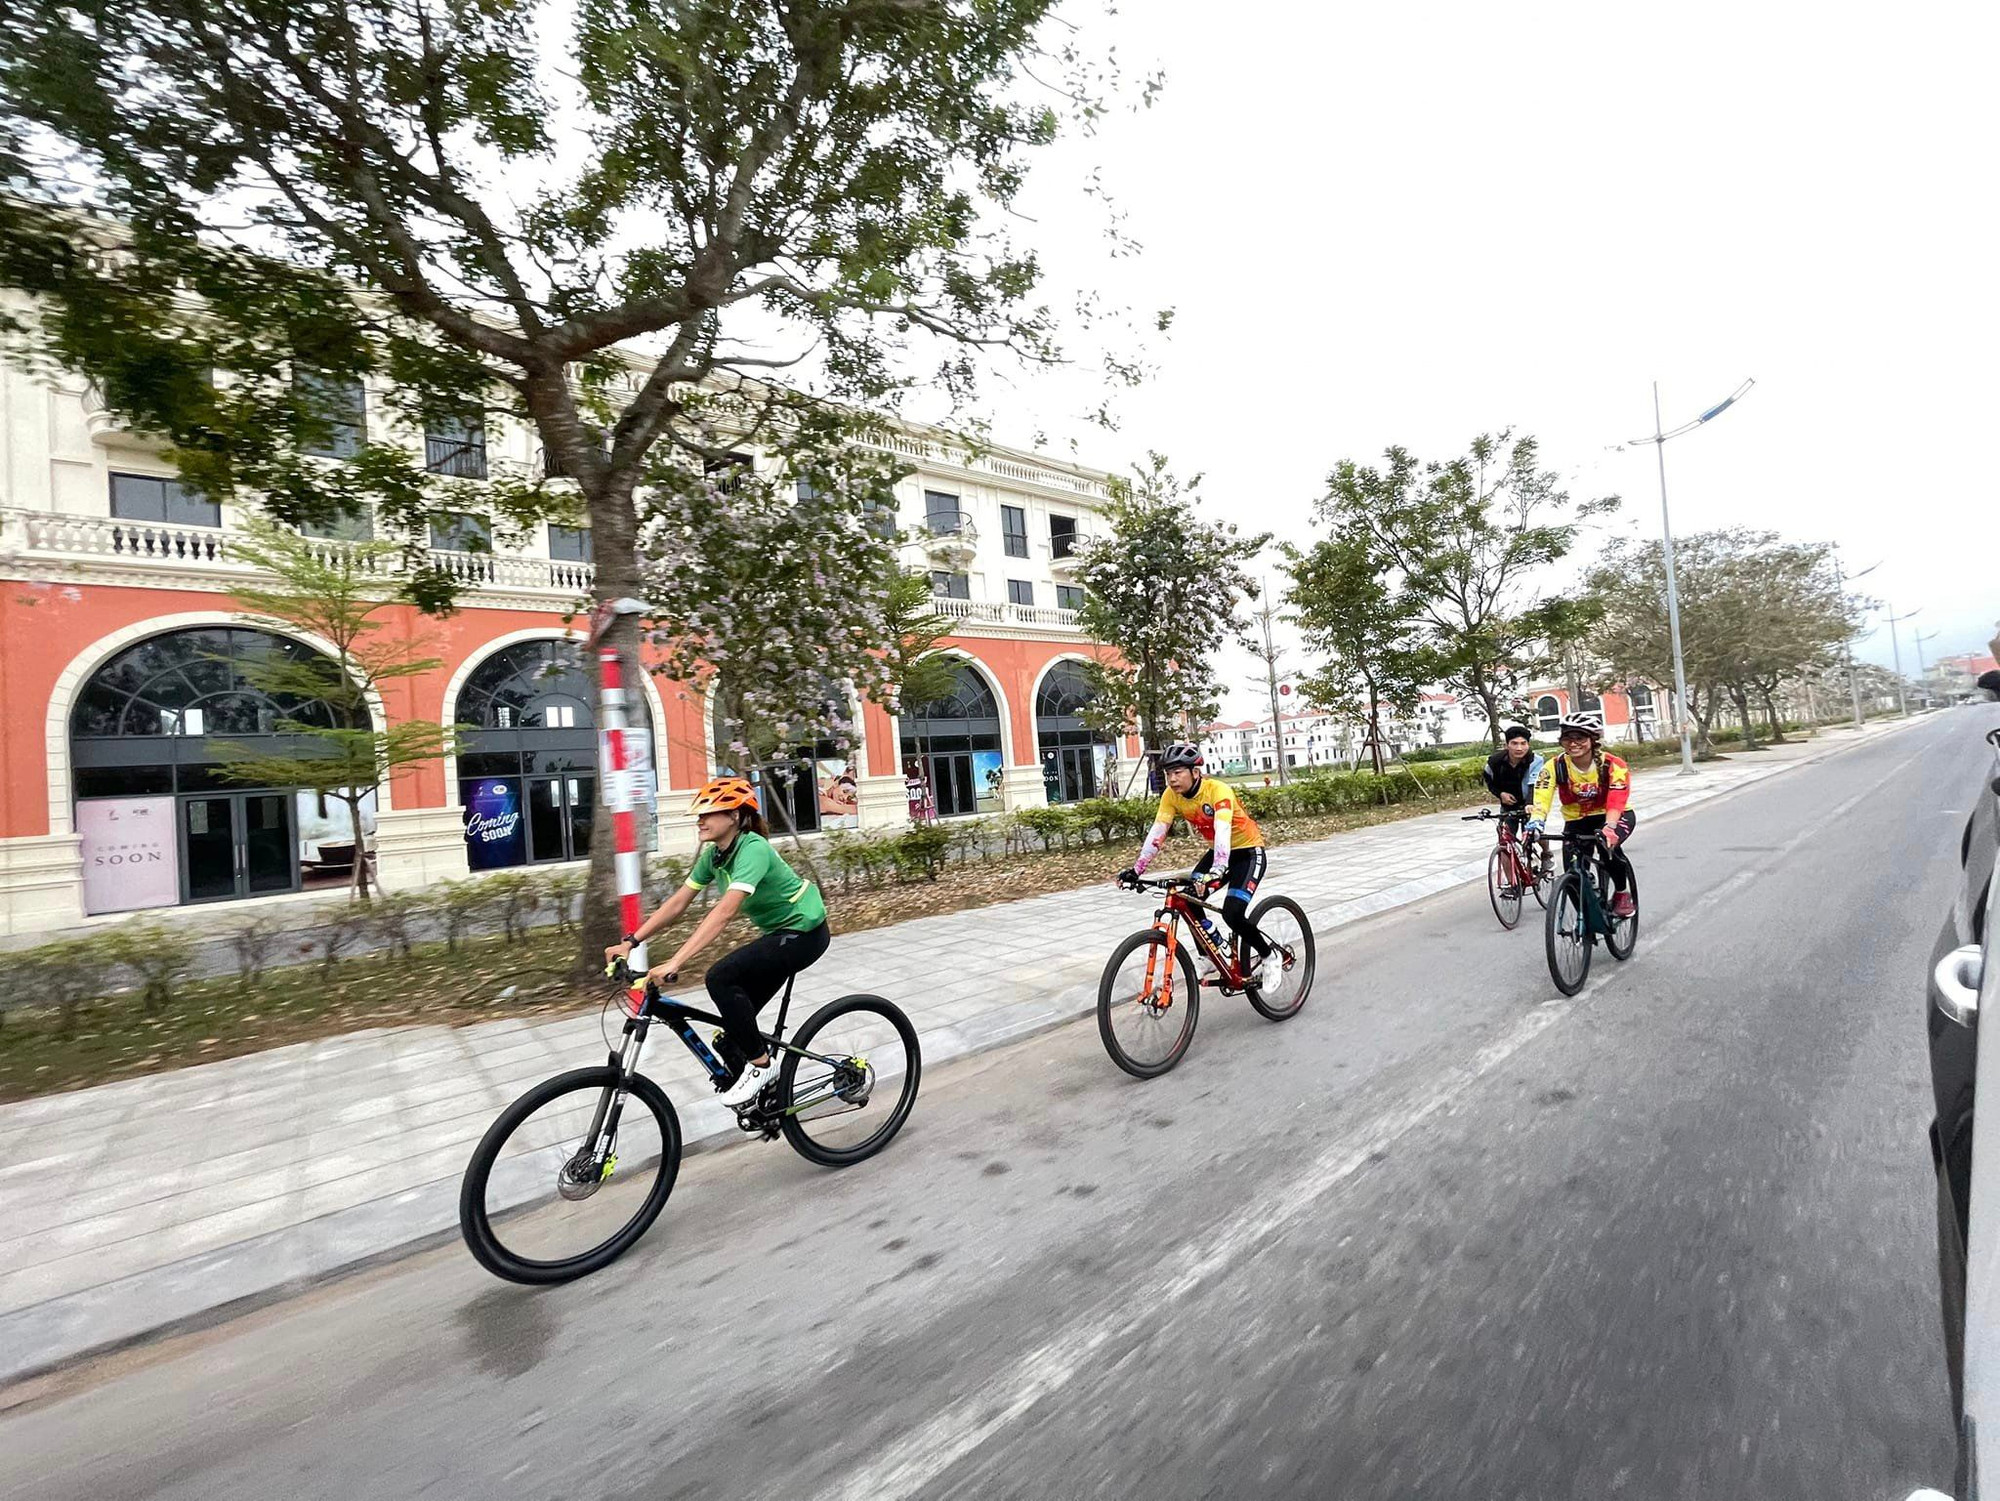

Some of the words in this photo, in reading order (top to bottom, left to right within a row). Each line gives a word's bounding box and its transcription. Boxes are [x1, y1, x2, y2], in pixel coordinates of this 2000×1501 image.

[467, 811, 519, 836] Coming
[481, 825, 512, 842] SOON
[95, 851, 161, 866] SOON
